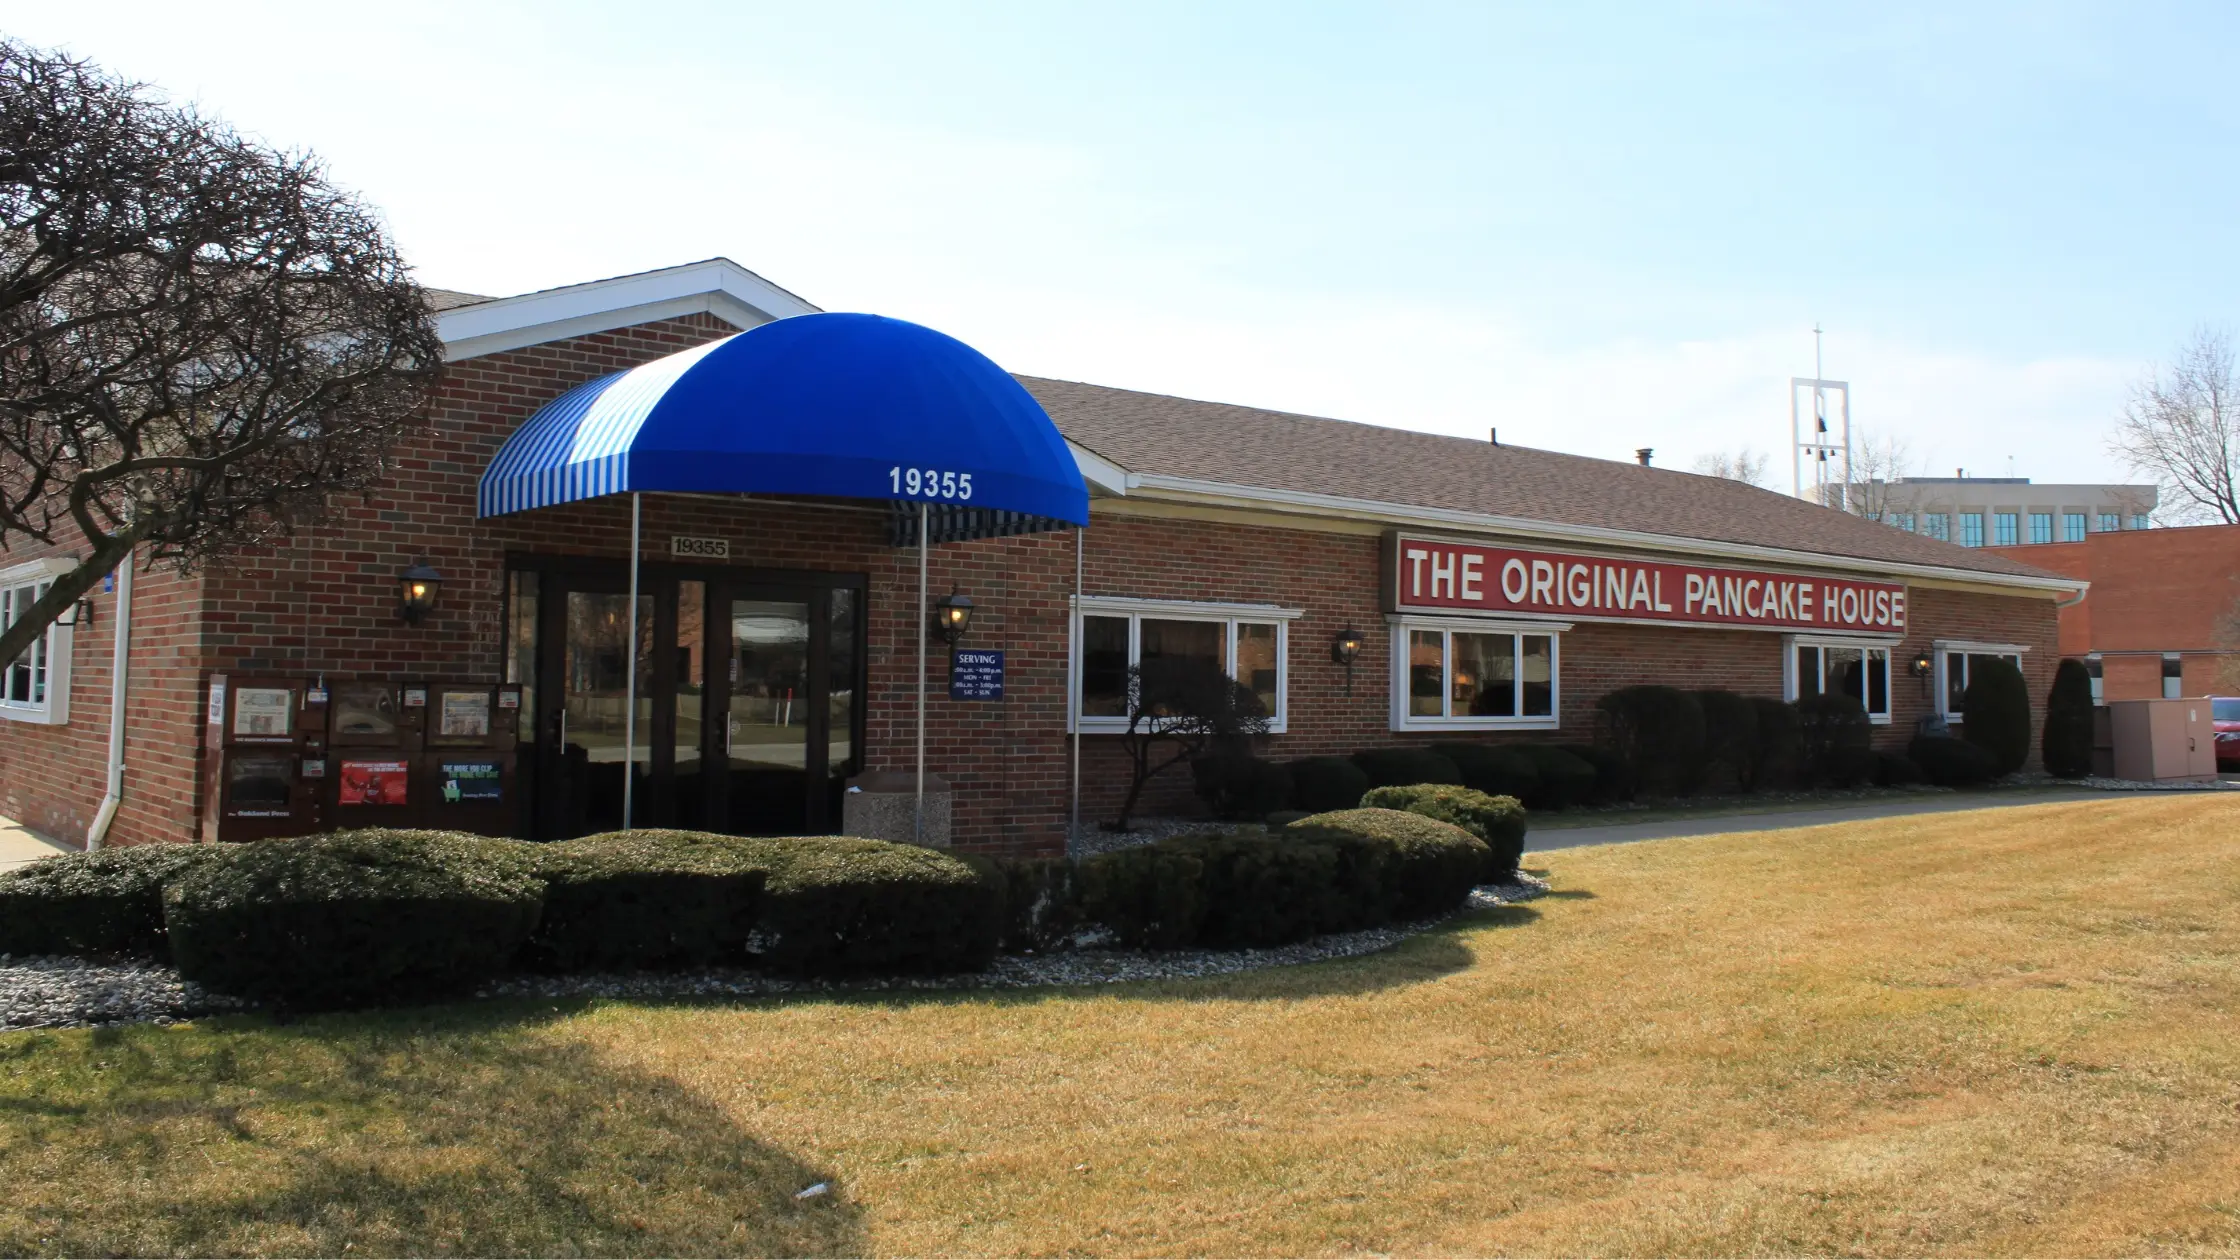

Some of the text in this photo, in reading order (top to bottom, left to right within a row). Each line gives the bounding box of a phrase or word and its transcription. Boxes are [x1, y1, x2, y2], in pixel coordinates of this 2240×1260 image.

[889, 466, 973, 500] 19355
[675, 538, 726, 556] 19355
[1407, 548, 1905, 627] THE ORIGINAL PANCAKE HOUSE
[958, 654, 996, 664] SERVING
[442, 764, 453, 772] THE
[480, 764, 493, 772] CLIP
